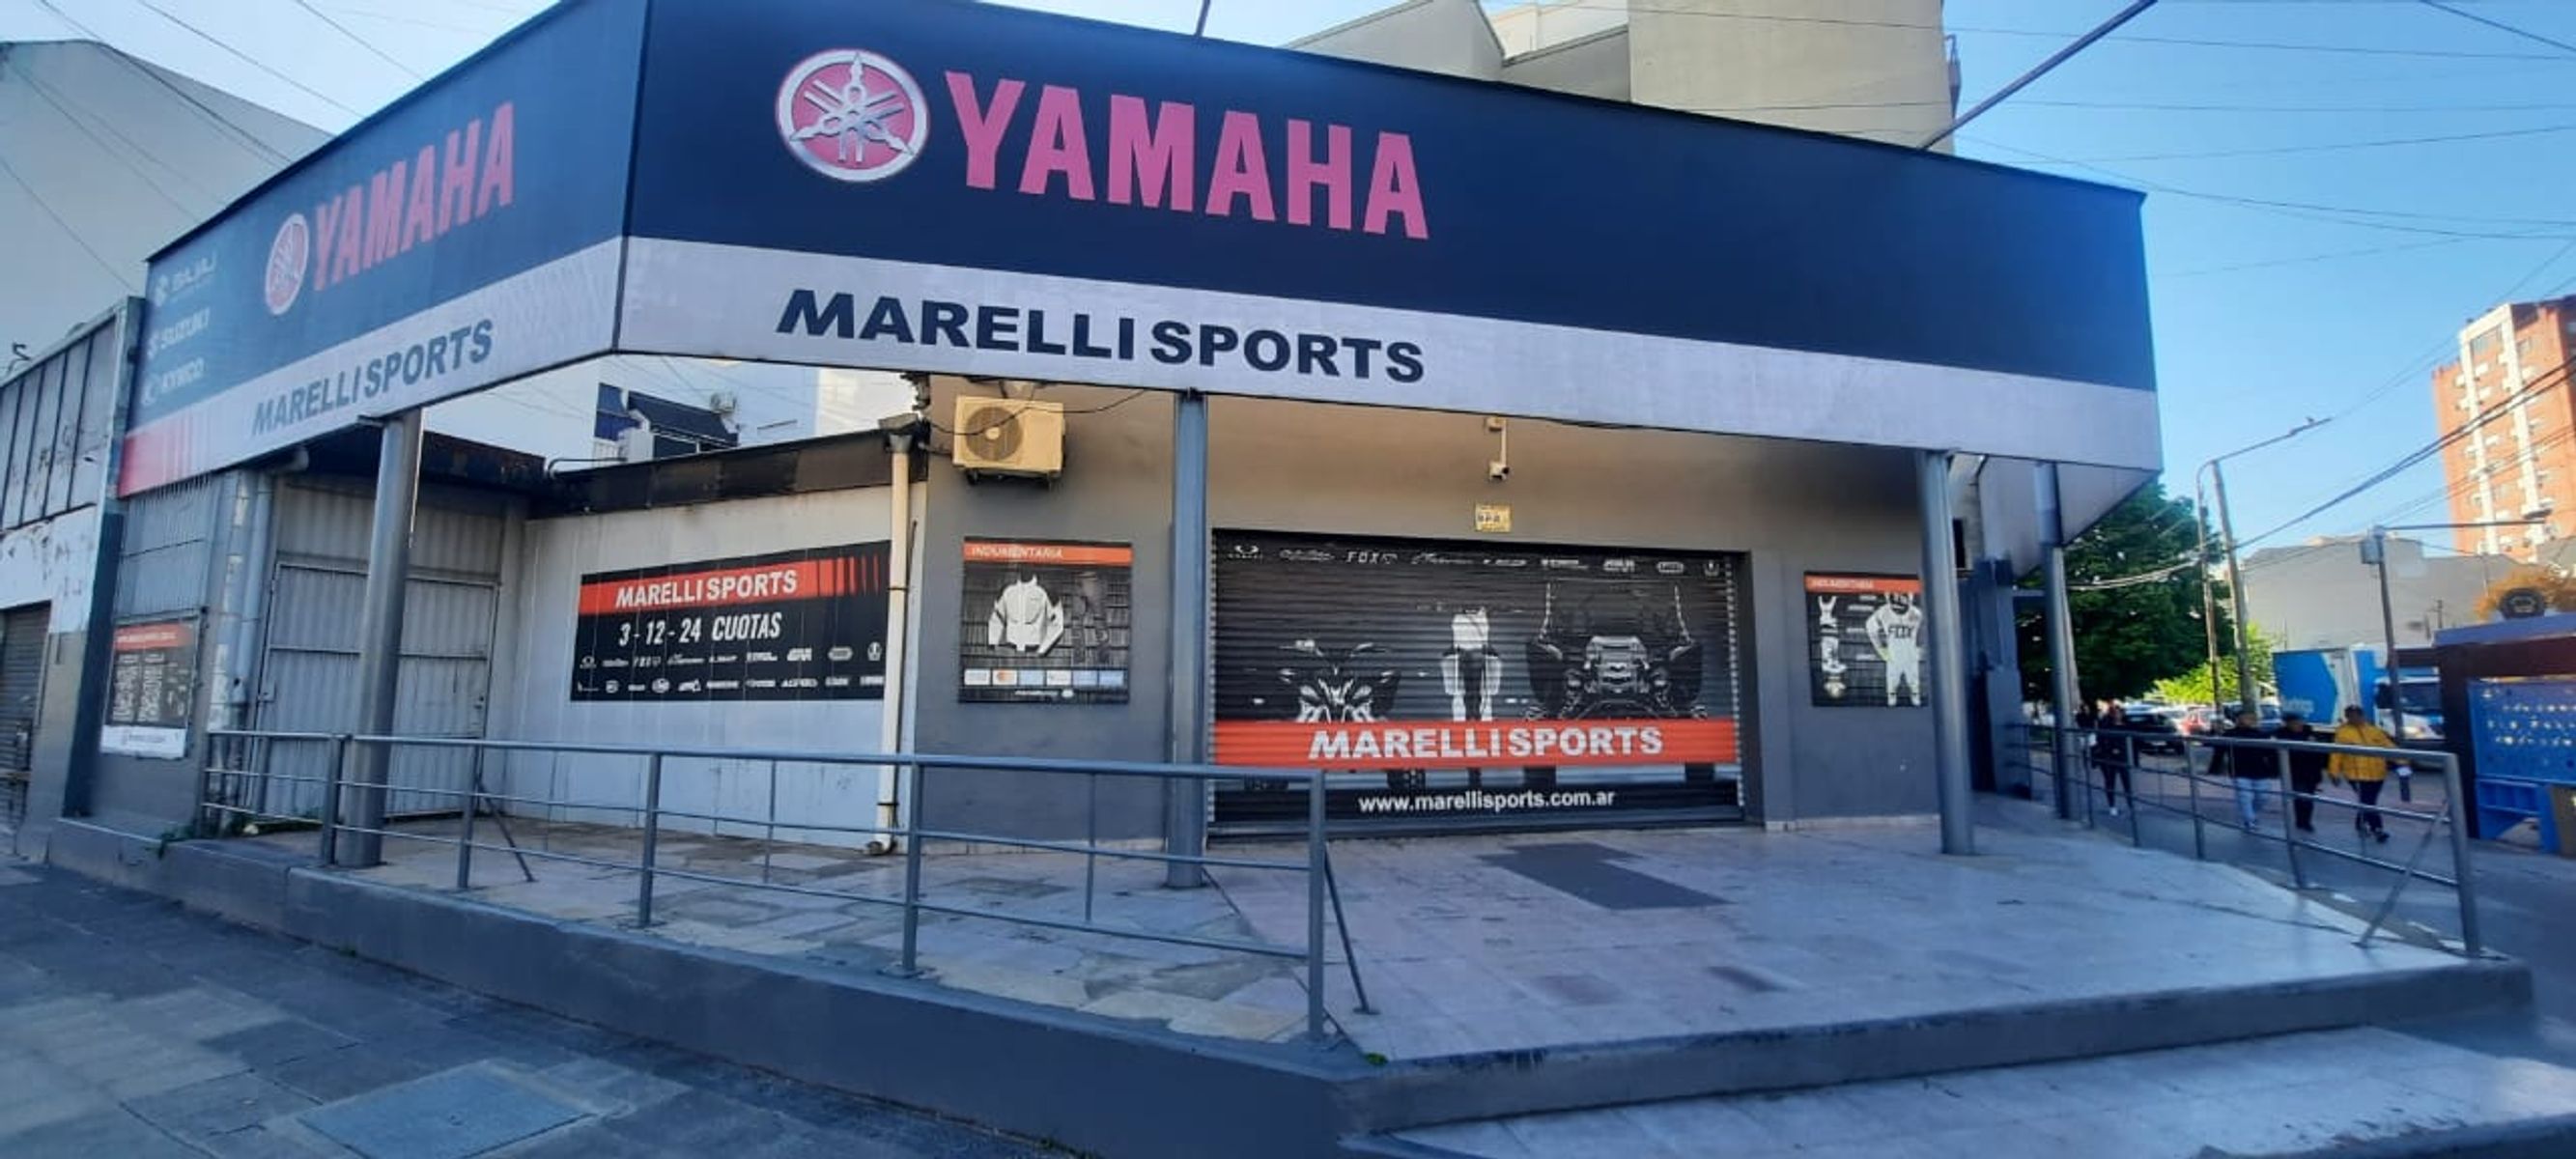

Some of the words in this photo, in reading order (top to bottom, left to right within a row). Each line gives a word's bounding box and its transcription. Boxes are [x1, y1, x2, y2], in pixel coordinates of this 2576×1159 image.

[945, 71, 1430, 240] YAMAHA
[313, 102, 513, 291] YAMAHA
[365, 319, 494, 396] SPORTS
[776, 289, 1135, 361] MARELLI
[1149, 320, 1426, 384] SPORTS
[707, 569, 797, 600] SPORTS
[618, 622, 632, 646] 3
[645, 620, 666, 645] 12
[679, 617, 702, 644] 24
[711, 611, 783, 642] CUOTAS
[1509, 725, 1663, 756] SPORTS
[1358, 788, 1616, 815] www.marellisports.com.ar
